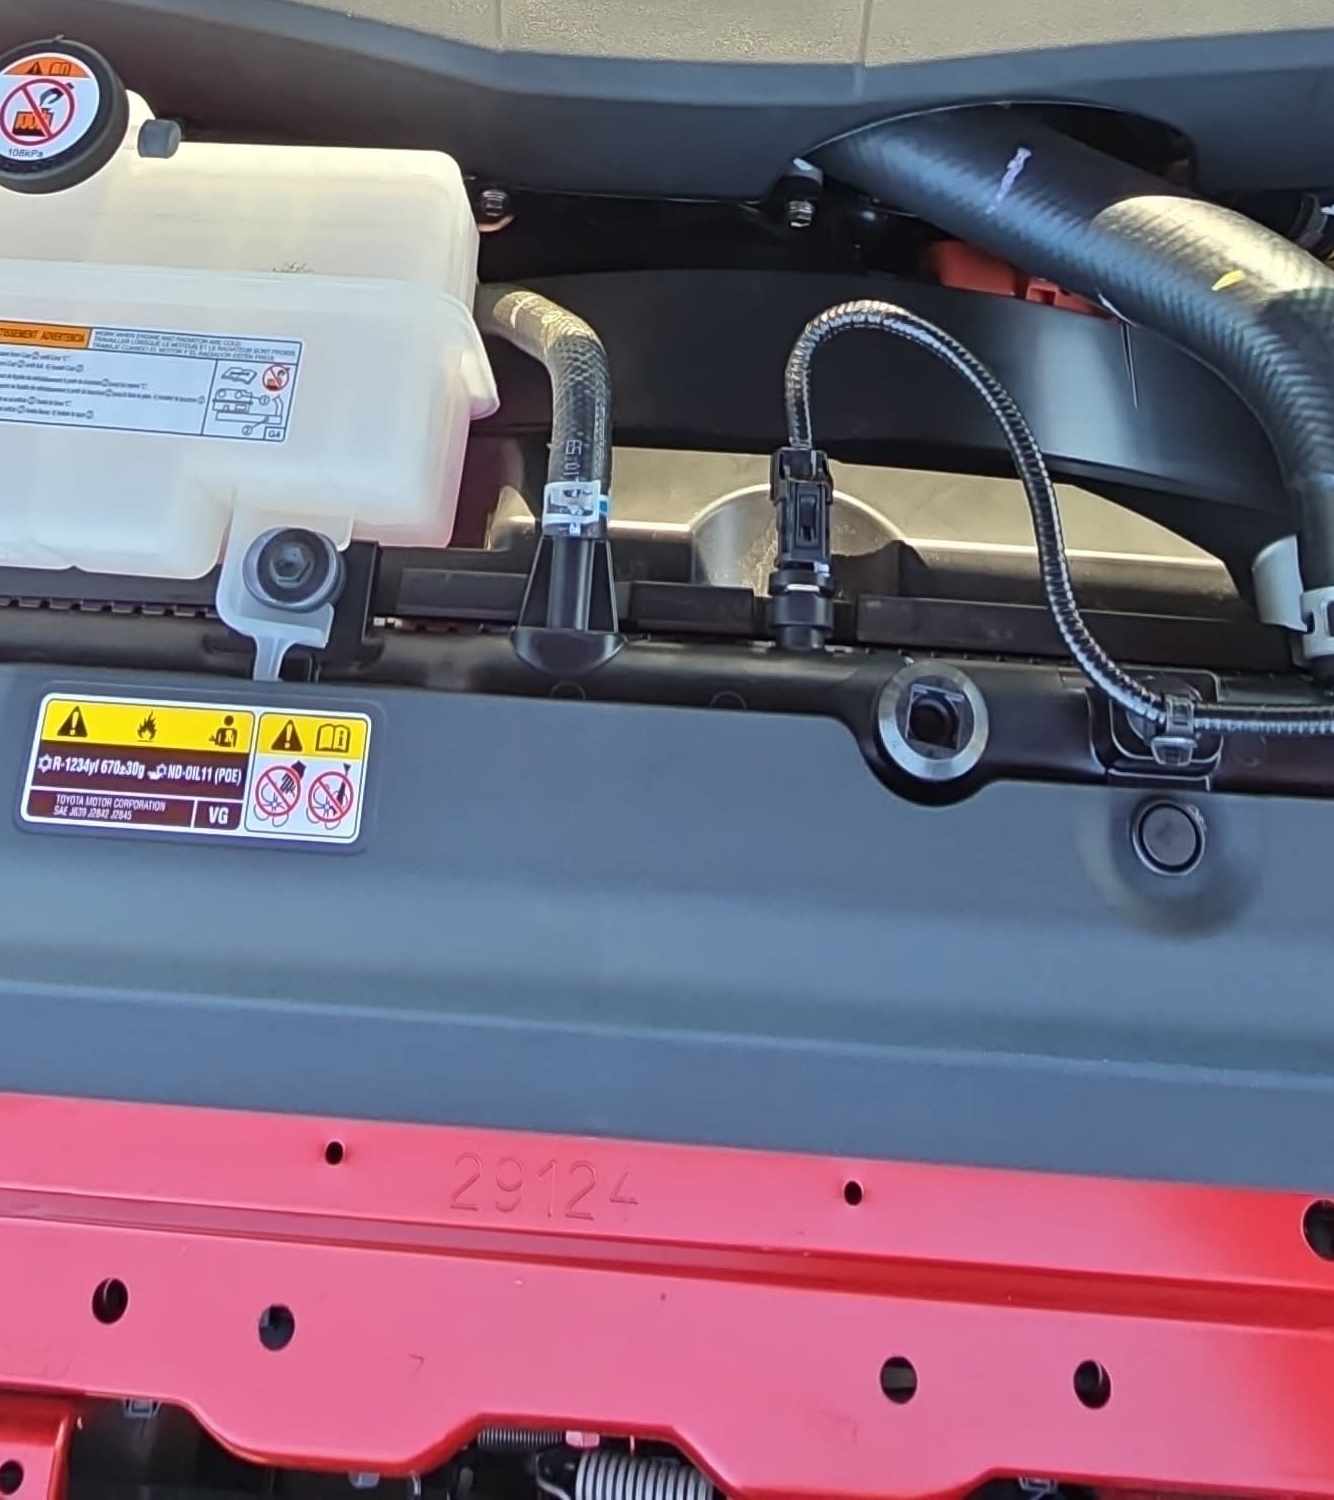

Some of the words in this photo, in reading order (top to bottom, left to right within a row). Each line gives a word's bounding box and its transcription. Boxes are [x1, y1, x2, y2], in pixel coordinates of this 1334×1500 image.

[268, 430, 281, 439] G4
[214, 768, 242, 787] (POE)
[53, 805, 68, 816] SAE
[56, 794, 84, 806] TOYOTA
[86, 796, 112, 808] MOTOR
[114, 798, 166, 812] CORPORATION
[208, 806, 229, 824] VG
[450, 1151, 639, 1222] 29124
